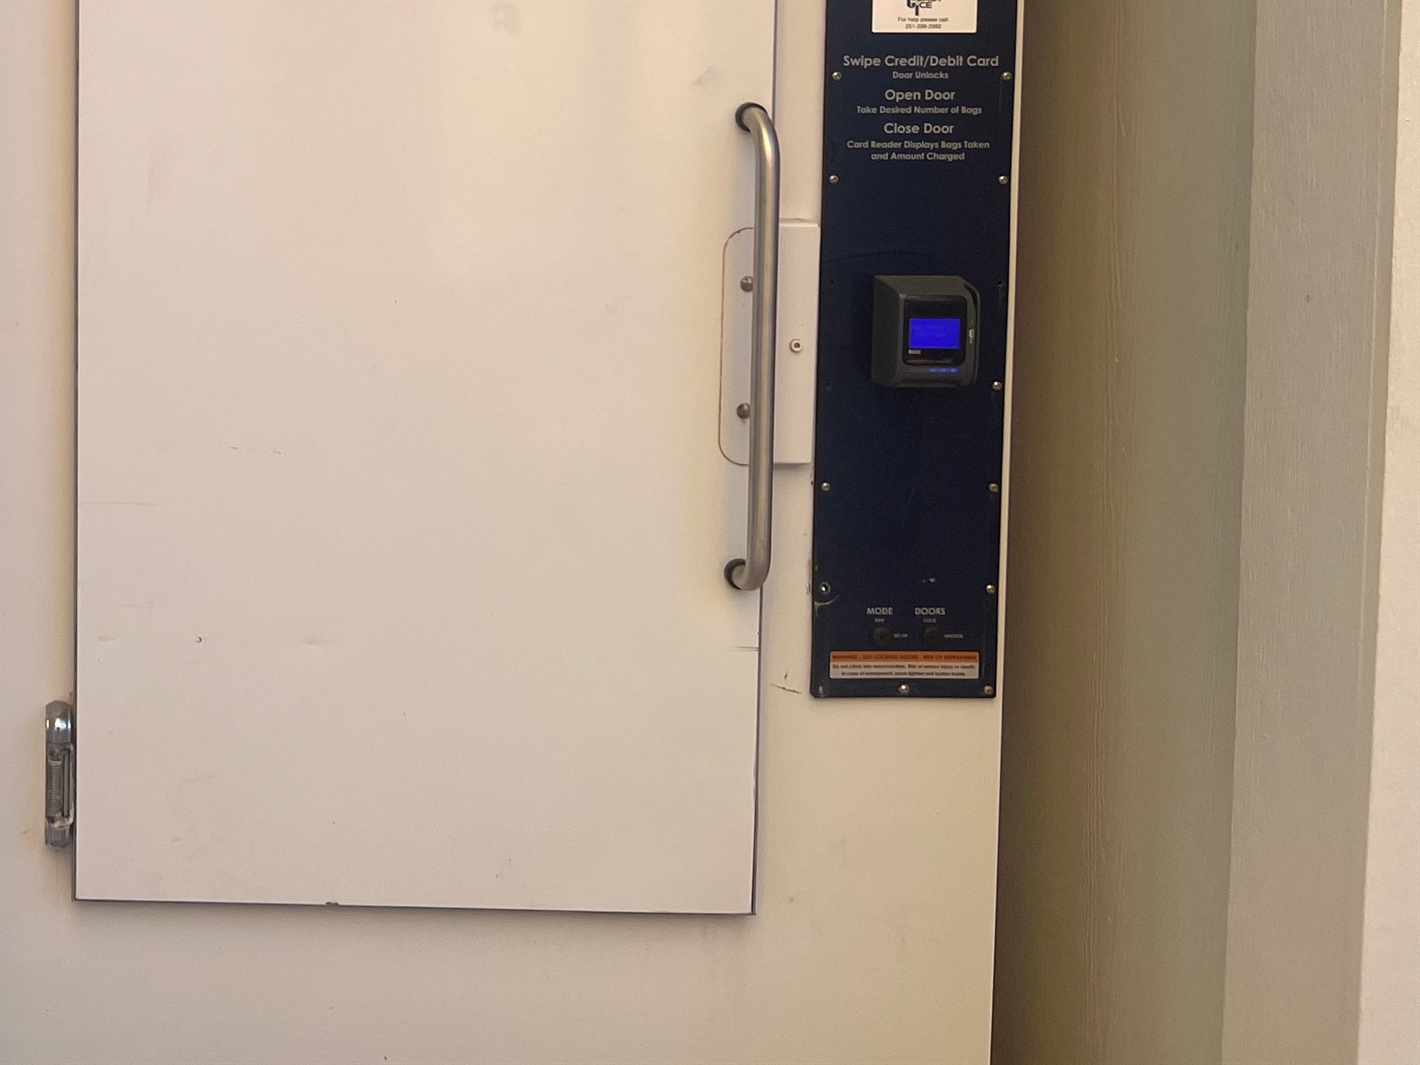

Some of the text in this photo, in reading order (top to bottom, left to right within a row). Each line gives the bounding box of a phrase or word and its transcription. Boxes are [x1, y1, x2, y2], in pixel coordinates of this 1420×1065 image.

[843, 55, 999, 68] Swipe Credit/Debit Card
[892, 71, 949, 79] Door Unlocks
[884, 89, 955, 102] Open Door
[856, 106, 982, 116] Take Desired Number of Bags
[883, 122, 955, 134] Close Door
[846, 140, 990, 150] Card Reader Displays Bags Taken
[871, 152, 965, 162] and Amount Charged
[866, 607, 946, 615] MODE DOORS
